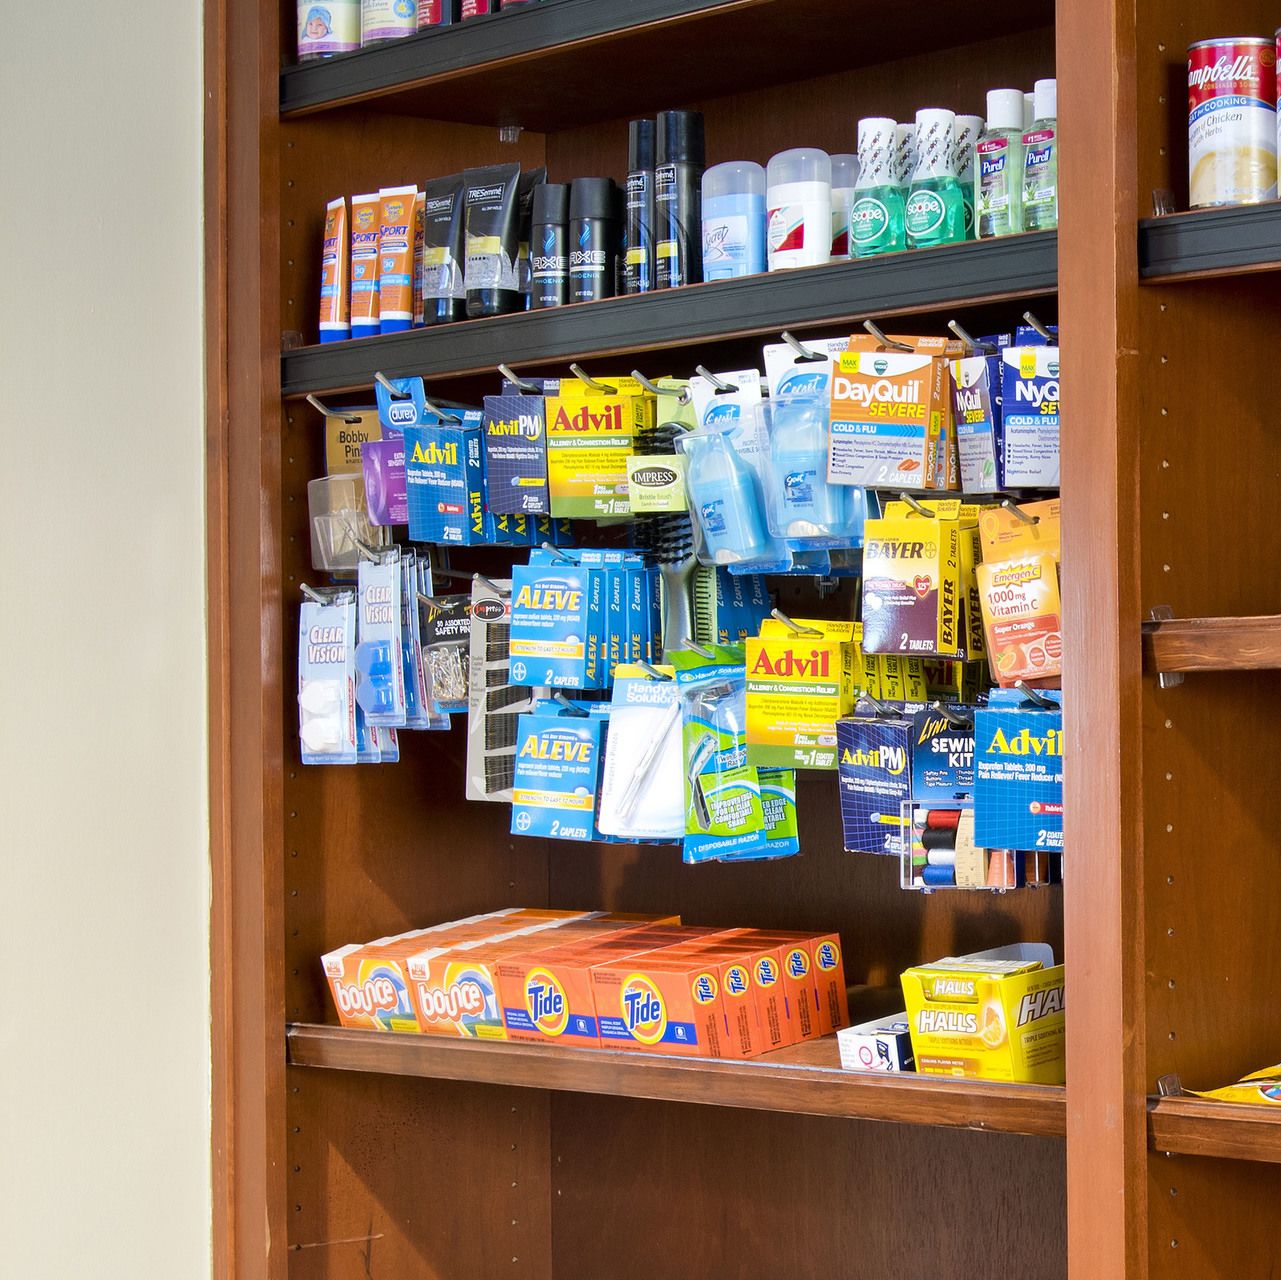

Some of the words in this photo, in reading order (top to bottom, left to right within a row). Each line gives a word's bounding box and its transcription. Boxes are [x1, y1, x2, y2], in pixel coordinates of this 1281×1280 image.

[1205, 98, 1247, 112] COOKING
[1027, 148, 1052, 166] Purell
[468, 186, 503, 200] TRESemmé
[851, 209, 883, 222] scope
[907, 201, 939, 217] scope
[380, 224, 408, 239] SPORT
[570, 251, 606, 264] AXE
[834, 380, 919, 408] DayQuil
[390, 406, 416, 422] durex
[551, 404, 624, 432] Advil
[869, 403, 926, 418] SEVERE
[339, 430, 369, 444] Bobby
[833, 424, 854, 434] COLD
[862, 426, 877, 434] FLU
[410, 440, 458, 466] Advil
[633, 470, 675, 483] IMPRESS
[867, 542, 924, 559] BAYER
[366, 584, 392, 604] CLEAR
[515, 585, 582, 611] ALEVE
[1015, 592, 1026, 602] mg
[942, 578, 956, 646] BAYER
[989, 601, 1021, 618] Vitamin
[1027, 598, 1038, 610] C
[444, 619, 470, 628] ASSORTED
[309, 625, 343, 644] CLEAR
[756, 647, 829, 678] Advil
[748, 684, 772, 693] ALLERGY
[778, 685, 813, 694] CONGESTION
[814, 686, 836, 694] RELIEF
[519, 736, 592, 763] ALEVE
[791, 951, 806, 977] Tide
[336, 980, 398, 1012] bounce
[935, 980, 974, 996] HALLS
[420, 982, 482, 1018] bounce
[528, 985, 563, 1021] Tide
[625, 992, 660, 1031] Tide
[920, 1010, 977, 1034] HALLS
